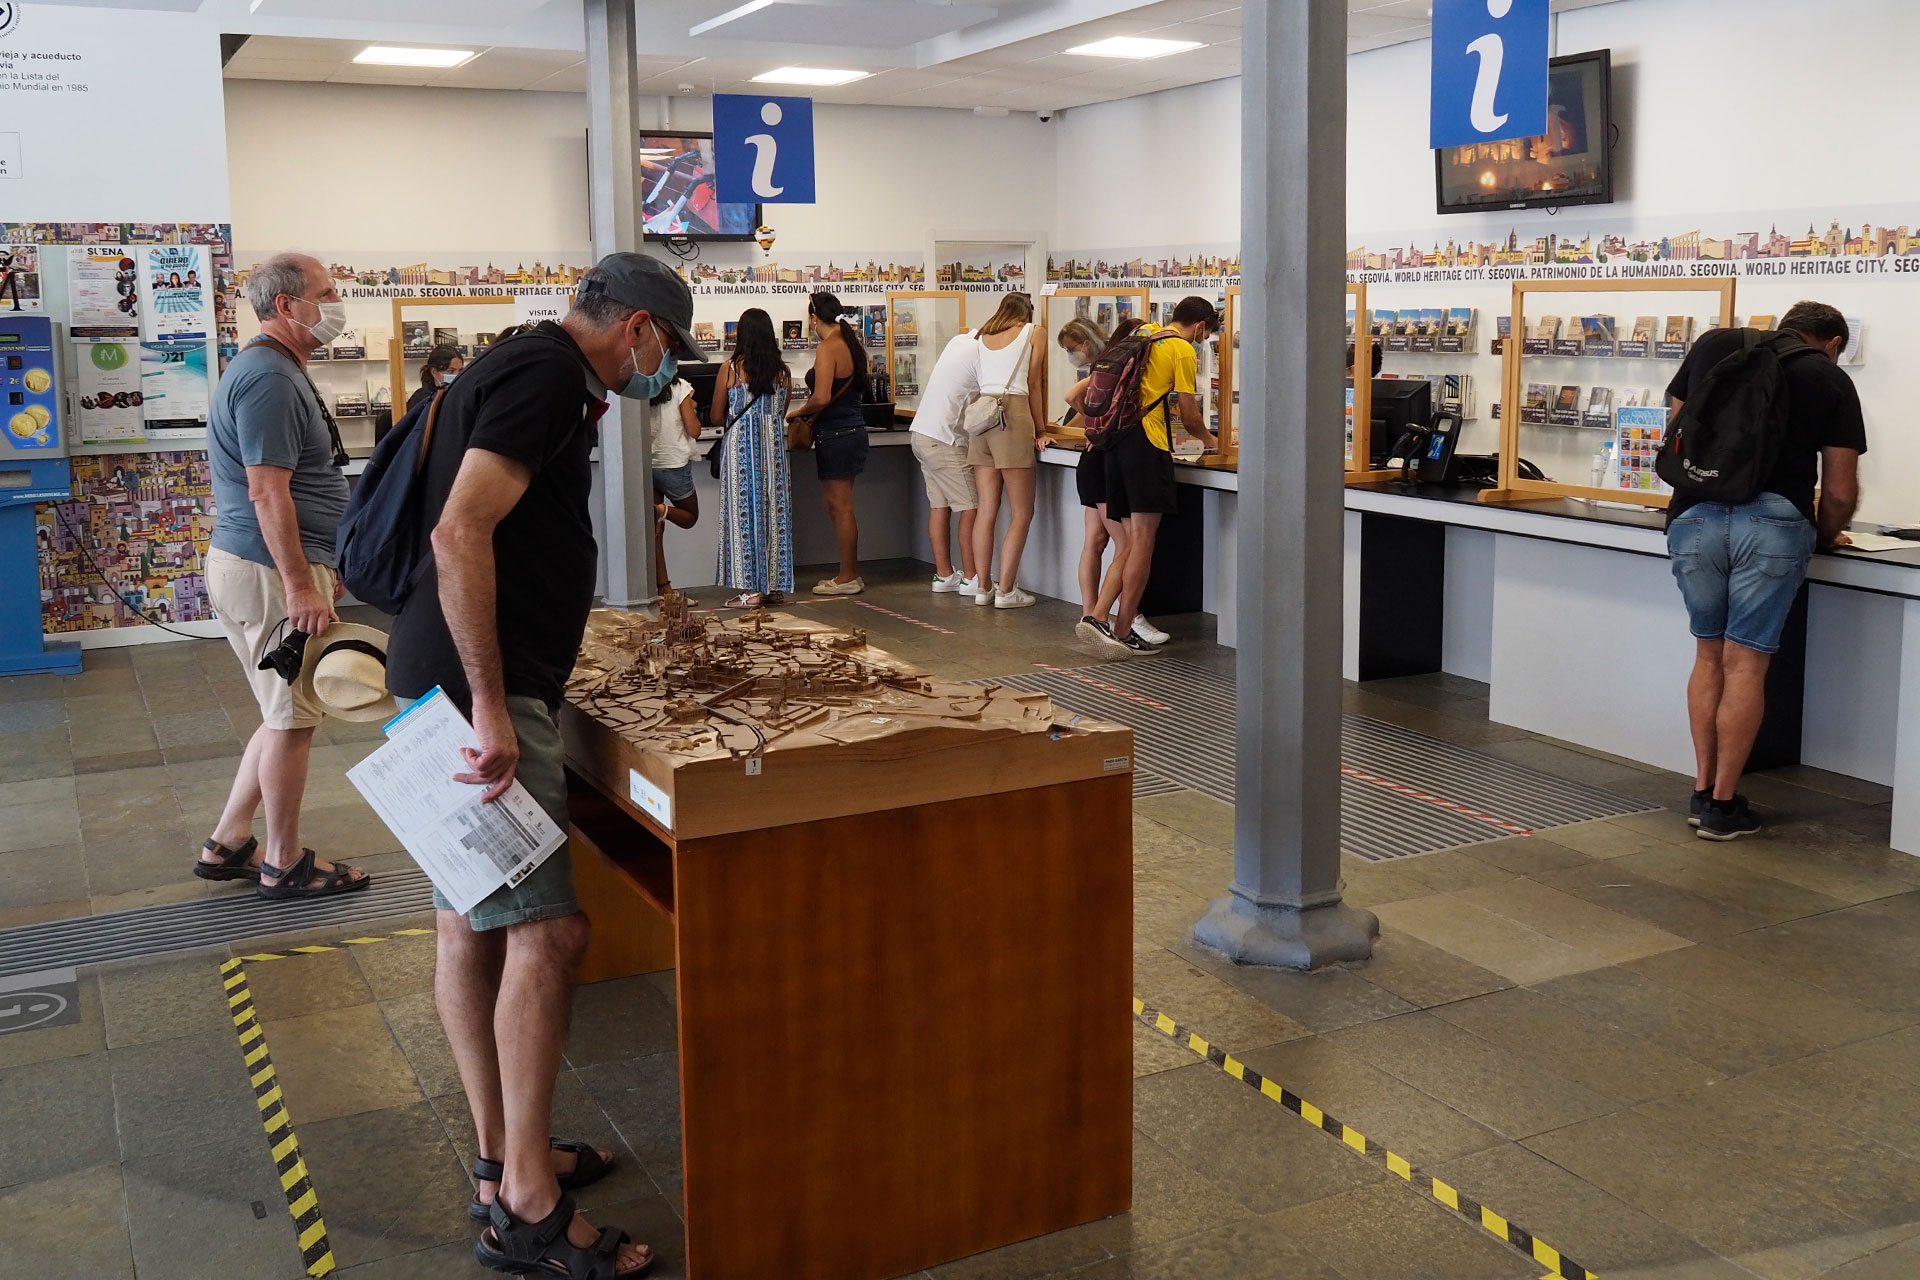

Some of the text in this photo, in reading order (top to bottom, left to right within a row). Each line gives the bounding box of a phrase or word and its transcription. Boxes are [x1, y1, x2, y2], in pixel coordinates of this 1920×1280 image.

[30, 52, 82, 61] acueducto
[10, 72, 19, 80] la
[21, 72, 43, 81] Lista
[45, 73, 60, 81] del
[13, 82, 49, 91] Mundial
[67, 84, 89, 92] 1985
[1359, 272, 1392, 284] SEGOVIA.
[1395, 271, 1421, 283] WORLD
[1423, 270, 1462, 282] HERITAGE
[1464, 268, 1485, 280] CITY.
[1488, 267, 1528, 280] SEGOVIA.
[1531, 266, 1587, 279] PATRIMONIO
[1590, 265, 1603, 278] DE
[1605, 265, 1618, 278] LA
[1621, 264, 1686, 278] HUMANIDAD.
[1690, 263, 1741, 277] SEGOVIA.
[1745, 261, 1787, 275] WORLD
[1790, 260, 1851, 275] HERITAGE
[1855, 259, 1888, 274] CITY.
[940, 284, 990, 293] PATRIMONIO
[993, 284, 1004, 292] DE
[1007, 284, 1018, 292] LA
[1137, 279, 1161, 289] SEGOVIA.
[1162, 279, 1181, 289] WORLD
[1182, 279, 1208, 288] HERITAGE
[1209, 278, 1224, 288] CITY.
[352, 287, 417, 298] HUMANIDAD.
[420, 286, 466, 298] SEGOVIA.
[469, 286, 503, 297] WORLD
[506, 286, 553, 296] HERITAGE
[701, 286, 711, 295] LA
[714, 285, 769, 295] HUMANIDAD.
[771, 284, 811, 294] SEGOVIA.
[813, 284, 841, 294] WORLD
[844, 284, 884, 294] HERITAGE
[528, 309, 558, 317] VISITAS
